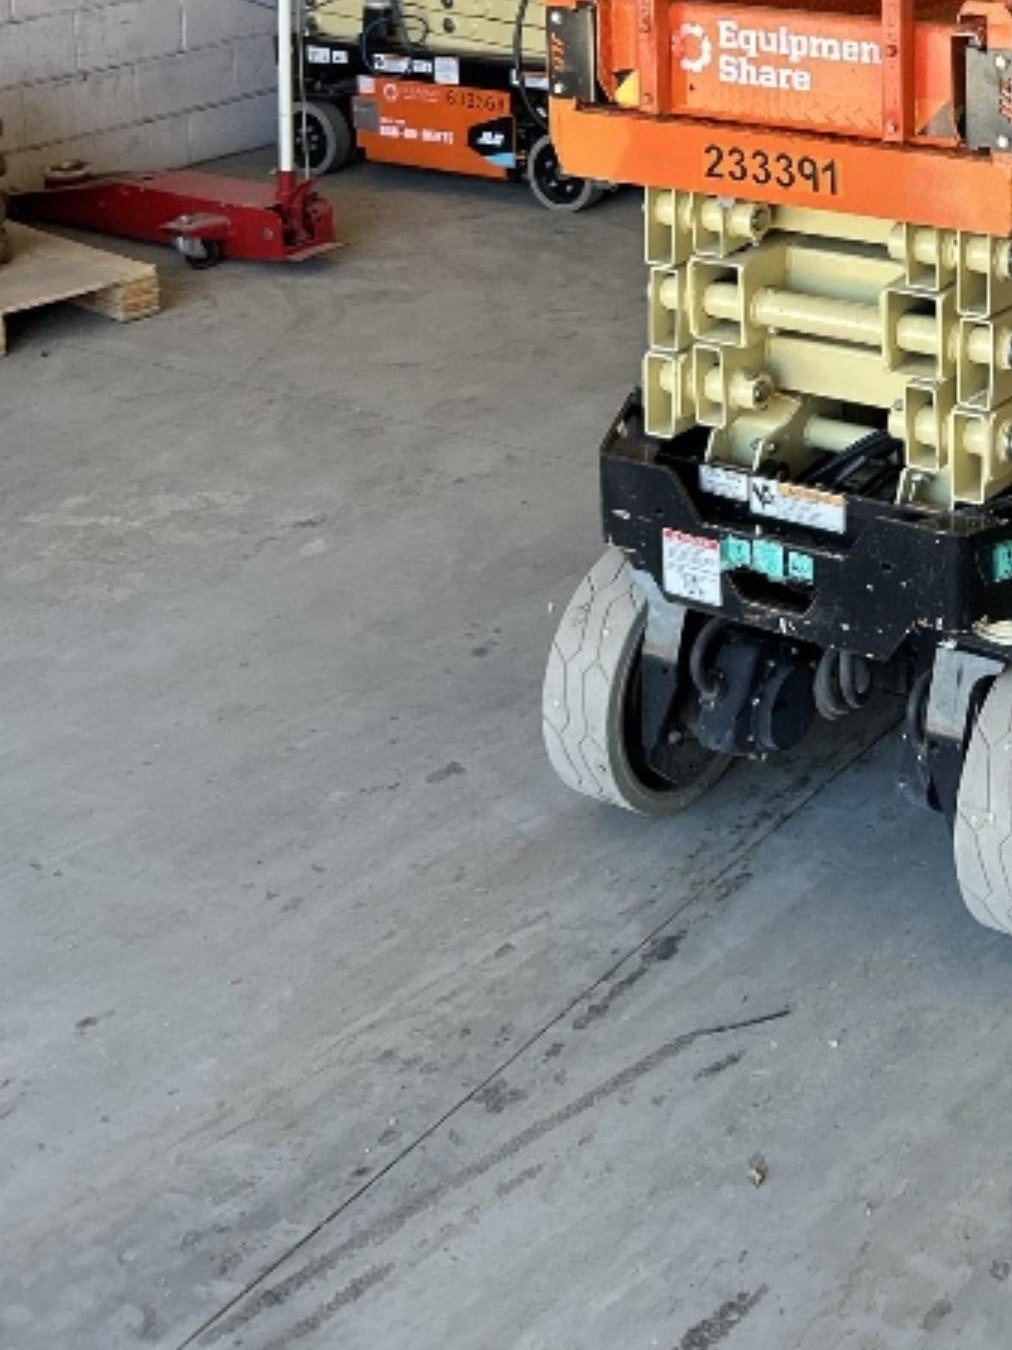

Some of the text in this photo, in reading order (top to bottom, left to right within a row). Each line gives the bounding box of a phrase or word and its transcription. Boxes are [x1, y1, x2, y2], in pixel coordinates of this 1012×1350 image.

[716, 19, 883, 65] Equipmen
[718, 54, 812, 91] Share
[703, 143, 838, 196] 233391
